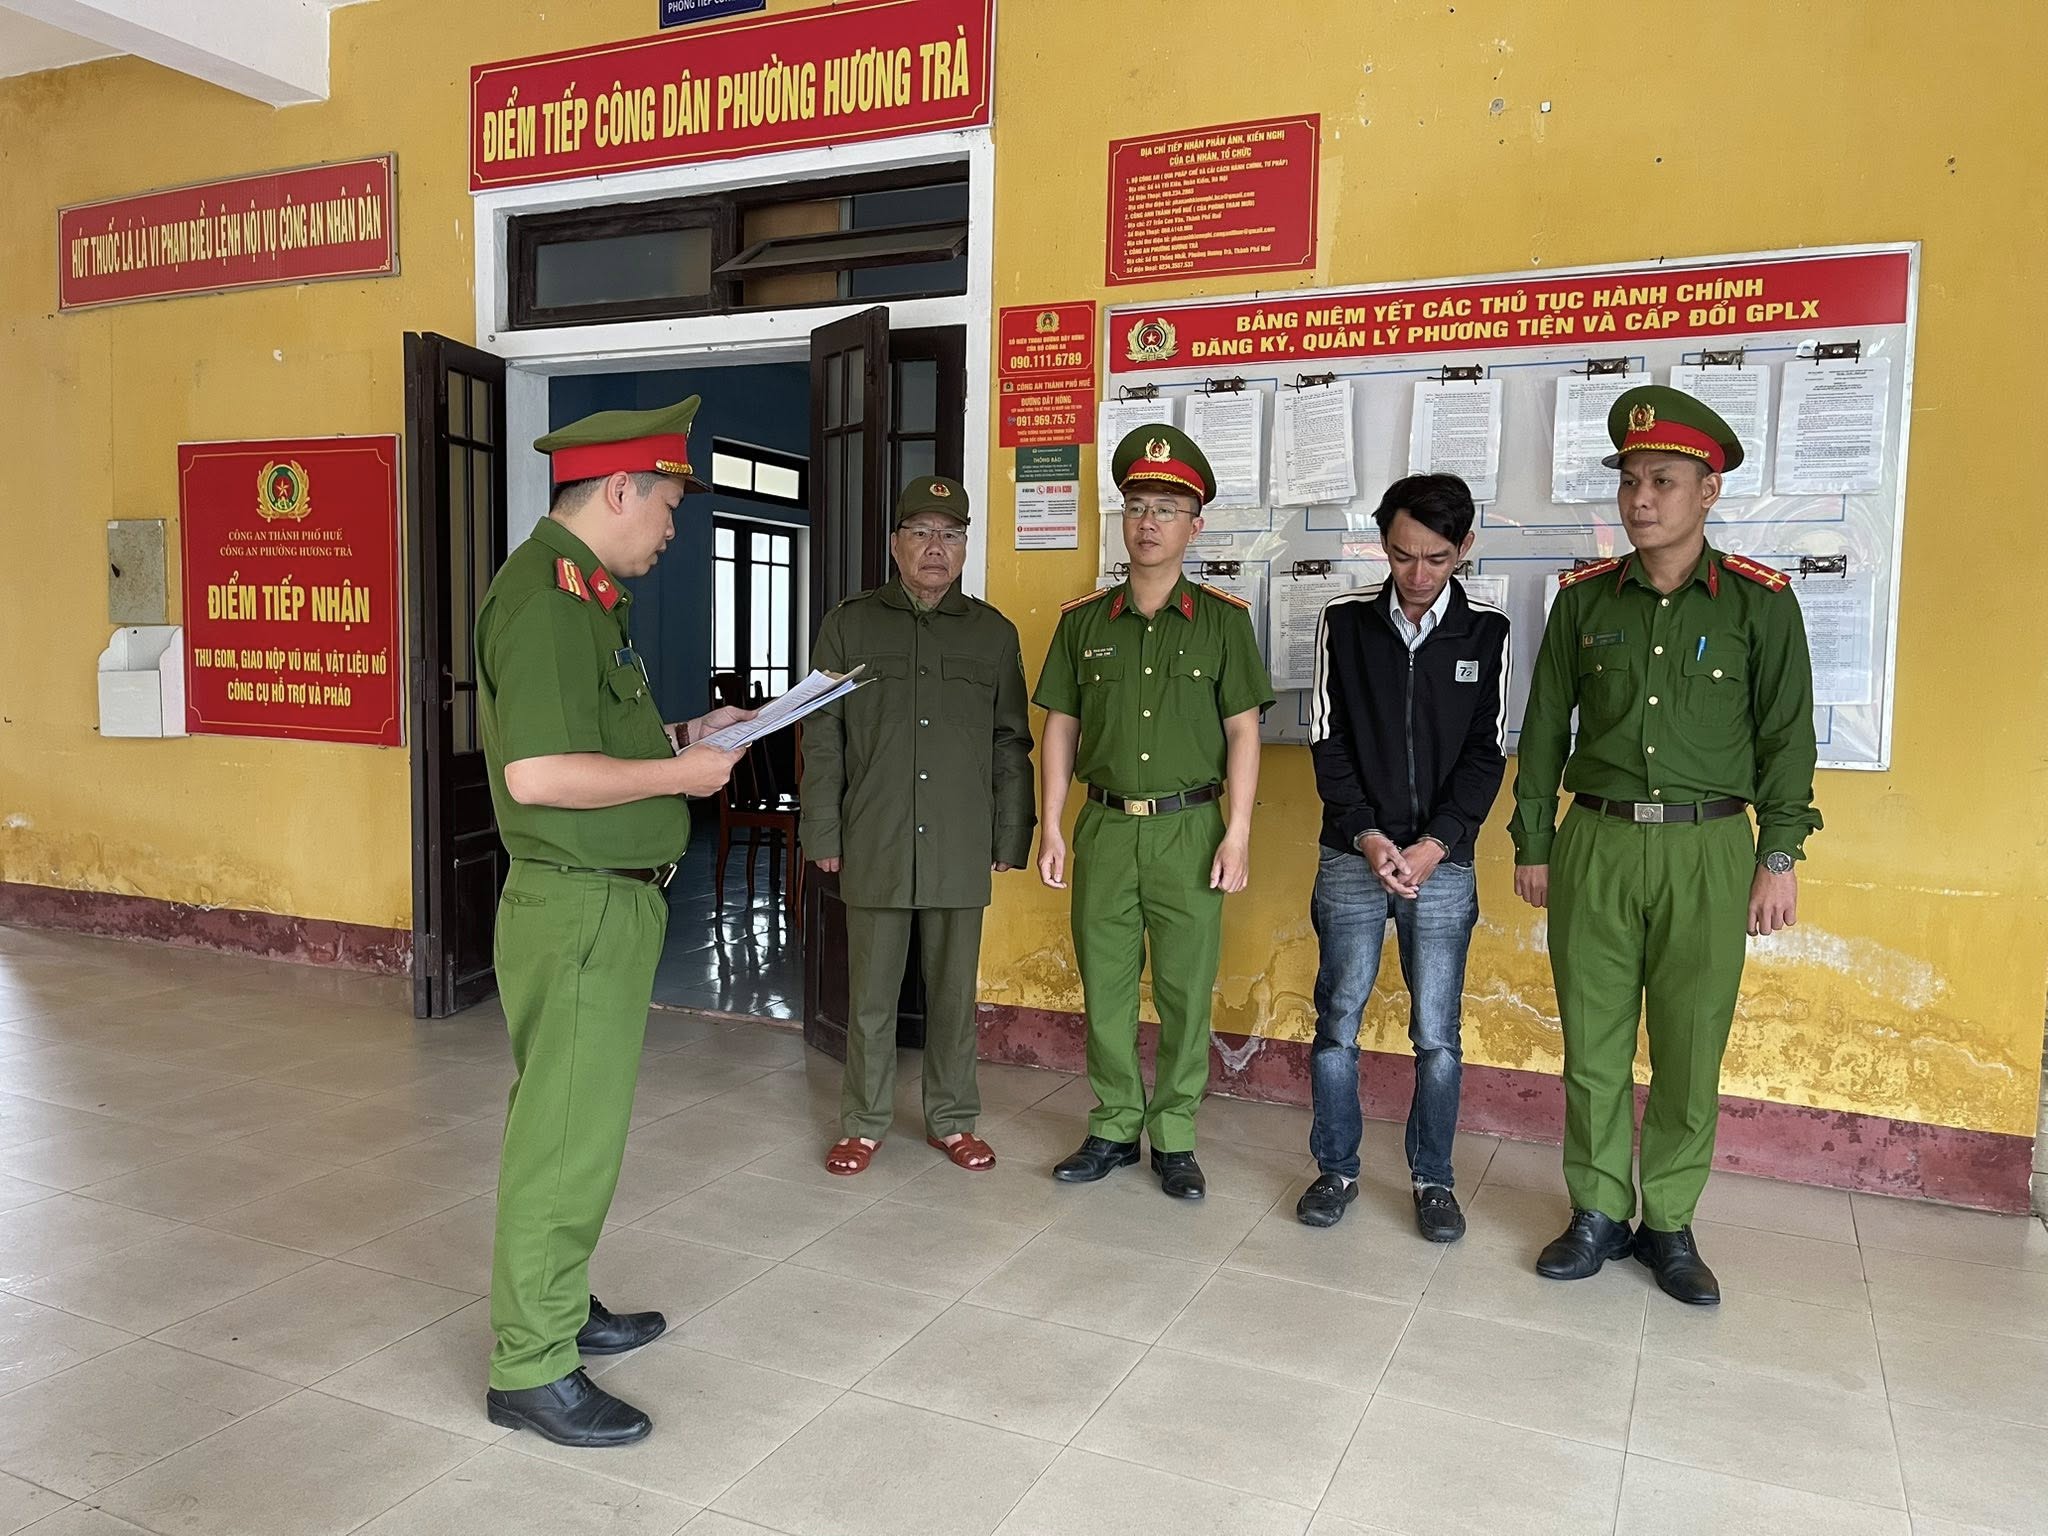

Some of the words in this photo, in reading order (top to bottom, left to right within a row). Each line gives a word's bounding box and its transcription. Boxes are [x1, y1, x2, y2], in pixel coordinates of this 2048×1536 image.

[483, 86, 536, 162] ĐIỂM
[542, 82, 588, 154] TIẾP
[595, 80, 655, 147] CÔNG
[662, 69, 711, 138] DÂN
[717, 54, 816, 130] PHƯỜNG
[823, 46, 911, 116] HƯƠNG
[920, 25, 970, 101] TRÀ
[1141, 147, 1152, 157] ĐỊA
[1168, 143, 1182, 153] TIẾP
[1184, 140, 1204, 151] NHẬN
[1247, 130, 1264, 142] KIẾN
[1267, 130, 1284, 141] NGHỊ
[1170, 155, 1183, 166] CỦA
[1232, 147, 1251, 157] CHỨC
[72, 227, 89, 278] HÚT
[91, 217, 119, 275] THUỐC
[122, 220, 133, 270] LÁ
[136, 217, 147, 267] LÀ
[150, 226, 159, 266] VI
[162, 223, 186, 272] PHẠM
[190, 200, 213, 261] ĐIỀU
[215, 204, 240, 265] LỆNH
[243, 199, 261, 263] NỘI
[263, 209, 276, 261] VỤ
[279, 194, 307, 250] CÔNG
[310, 202, 323, 244] AN
[326, 186, 355, 242] NHÂN
[358, 184, 381, 240] DÂN
[1237, 310, 1298, 332] BẢNG
[1306, 306, 1365, 327] NIÊM
[1373, 300, 1415, 322] YẾT
[1422, 296, 1472, 317] CÁC
[1480, 290, 1527, 314] THỦ
[1536, 291, 1584, 311] TỤC
[1593, 283, 1667, 308] HÀNH
[1676, 278, 1764, 302] CHÍNH
[1192, 335, 1252, 358] ĐĂNG
[1260, 330, 1295, 353] KÝ,
[1302, 326, 1365, 351] QUẢN
[1373, 324, 1400, 346] LÝ
[1407, 319, 1508, 344] PHƯƠNG
[1517, 314, 1573, 339] TIỆN
[1583, 311, 1616, 333] VÀ
[1625, 305, 1680, 330] CẤP
[1689, 300, 1735, 327] ĐỔI
[1746, 300, 1819, 322] GPLX
[1011, 352, 1081, 368] 090.111.6789
[1017, 383, 1033, 391] CÔNG
[1044, 380, 1064, 389] THÀNH
[1065, 379, 1077, 388] PHỐ
[1079, 378, 1090, 387] HUẾ
[1021, 396, 1041, 406] ĐƯỜNG
[1042, 395, 1054, 405] DÂY
[1055, 395, 1071, 404] NÓNG
[1017, 413, 1076, 426] 091.969.75.75
[228, 530, 252, 540] CÔNG
[254, 532, 266, 540] AN
[267, 530, 298, 540] THÀNH
[302, 529, 320, 540] PHỐ
[323, 528, 342, 540] HUẾ
[220, 546, 244, 556] CÔNG
[246, 548, 258, 556] AN
[260, 546, 297, 556] PHƯỜNG
[300, 547, 332, 556] HƯƠNG
[334, 546, 352, 556] TRÀ
[208, 570, 256, 620] ĐIỂM
[262, 574, 304, 621] TIẾP
[312, 579, 369, 630] NHẬN
[195, 649, 211, 667] THU
[215, 652, 238, 670] GOM,
[241, 652, 262, 668] GIAO
[266, 647, 285, 673] NỘP
[288, 648, 301, 670] VŨ
[304, 649, 323, 674] KHÍ,
[326, 648, 344, 675] VẬT
[347, 649, 368, 677] LIỆU
[372, 647, 386, 674] NỔ
[228, 678, 253, 700] CÔNG
[256, 684, 269, 706] CỤ
[272, 677, 284, 702] HỖ
[288, 684, 305, 708] TRỢ
[309, 681, 321, 704] VÀ
[324, 682, 350, 706] PHÁO
